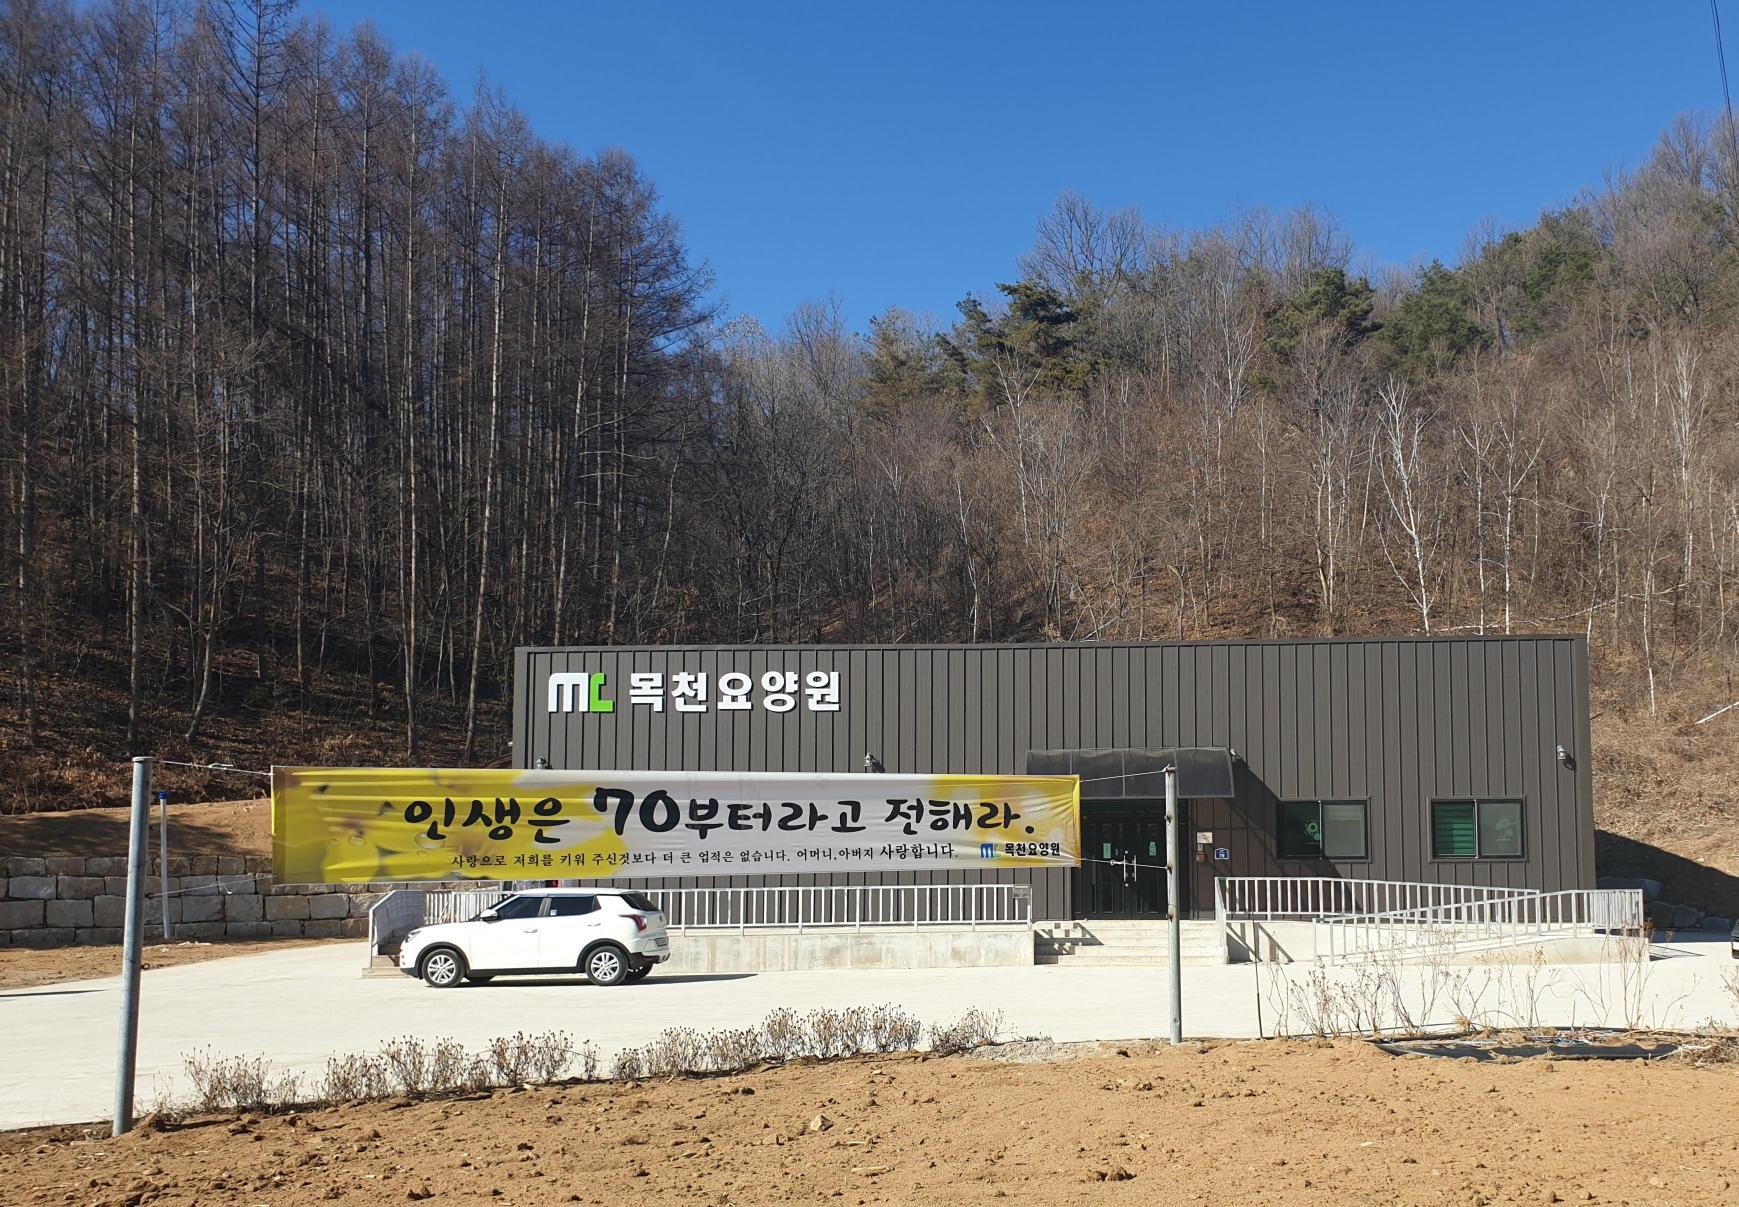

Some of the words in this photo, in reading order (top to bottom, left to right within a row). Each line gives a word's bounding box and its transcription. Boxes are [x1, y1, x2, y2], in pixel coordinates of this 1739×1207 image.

[629, 671, 840, 713] 목천요양원
[404, 797, 570, 844] 인생은
[593, 787, 867, 839] 70부터라고
[885, 797, 1035, 835] 전해라.
[451, 854, 508, 868] 사랑으로
[514, 854, 554, 867] 저희를
[560, 853, 585, 866] 키워
[592, 851, 657, 866] 주신것보다
[663, 851, 673, 864] 더
[680, 852, 692, 864] 큰
[698, 850, 734, 863] 업적은
[740, 849, 790, 862] 없습니다.
[880, 843, 958, 860] 사랑합니다.
[1004, 842, 1061, 857] 목천요양원
